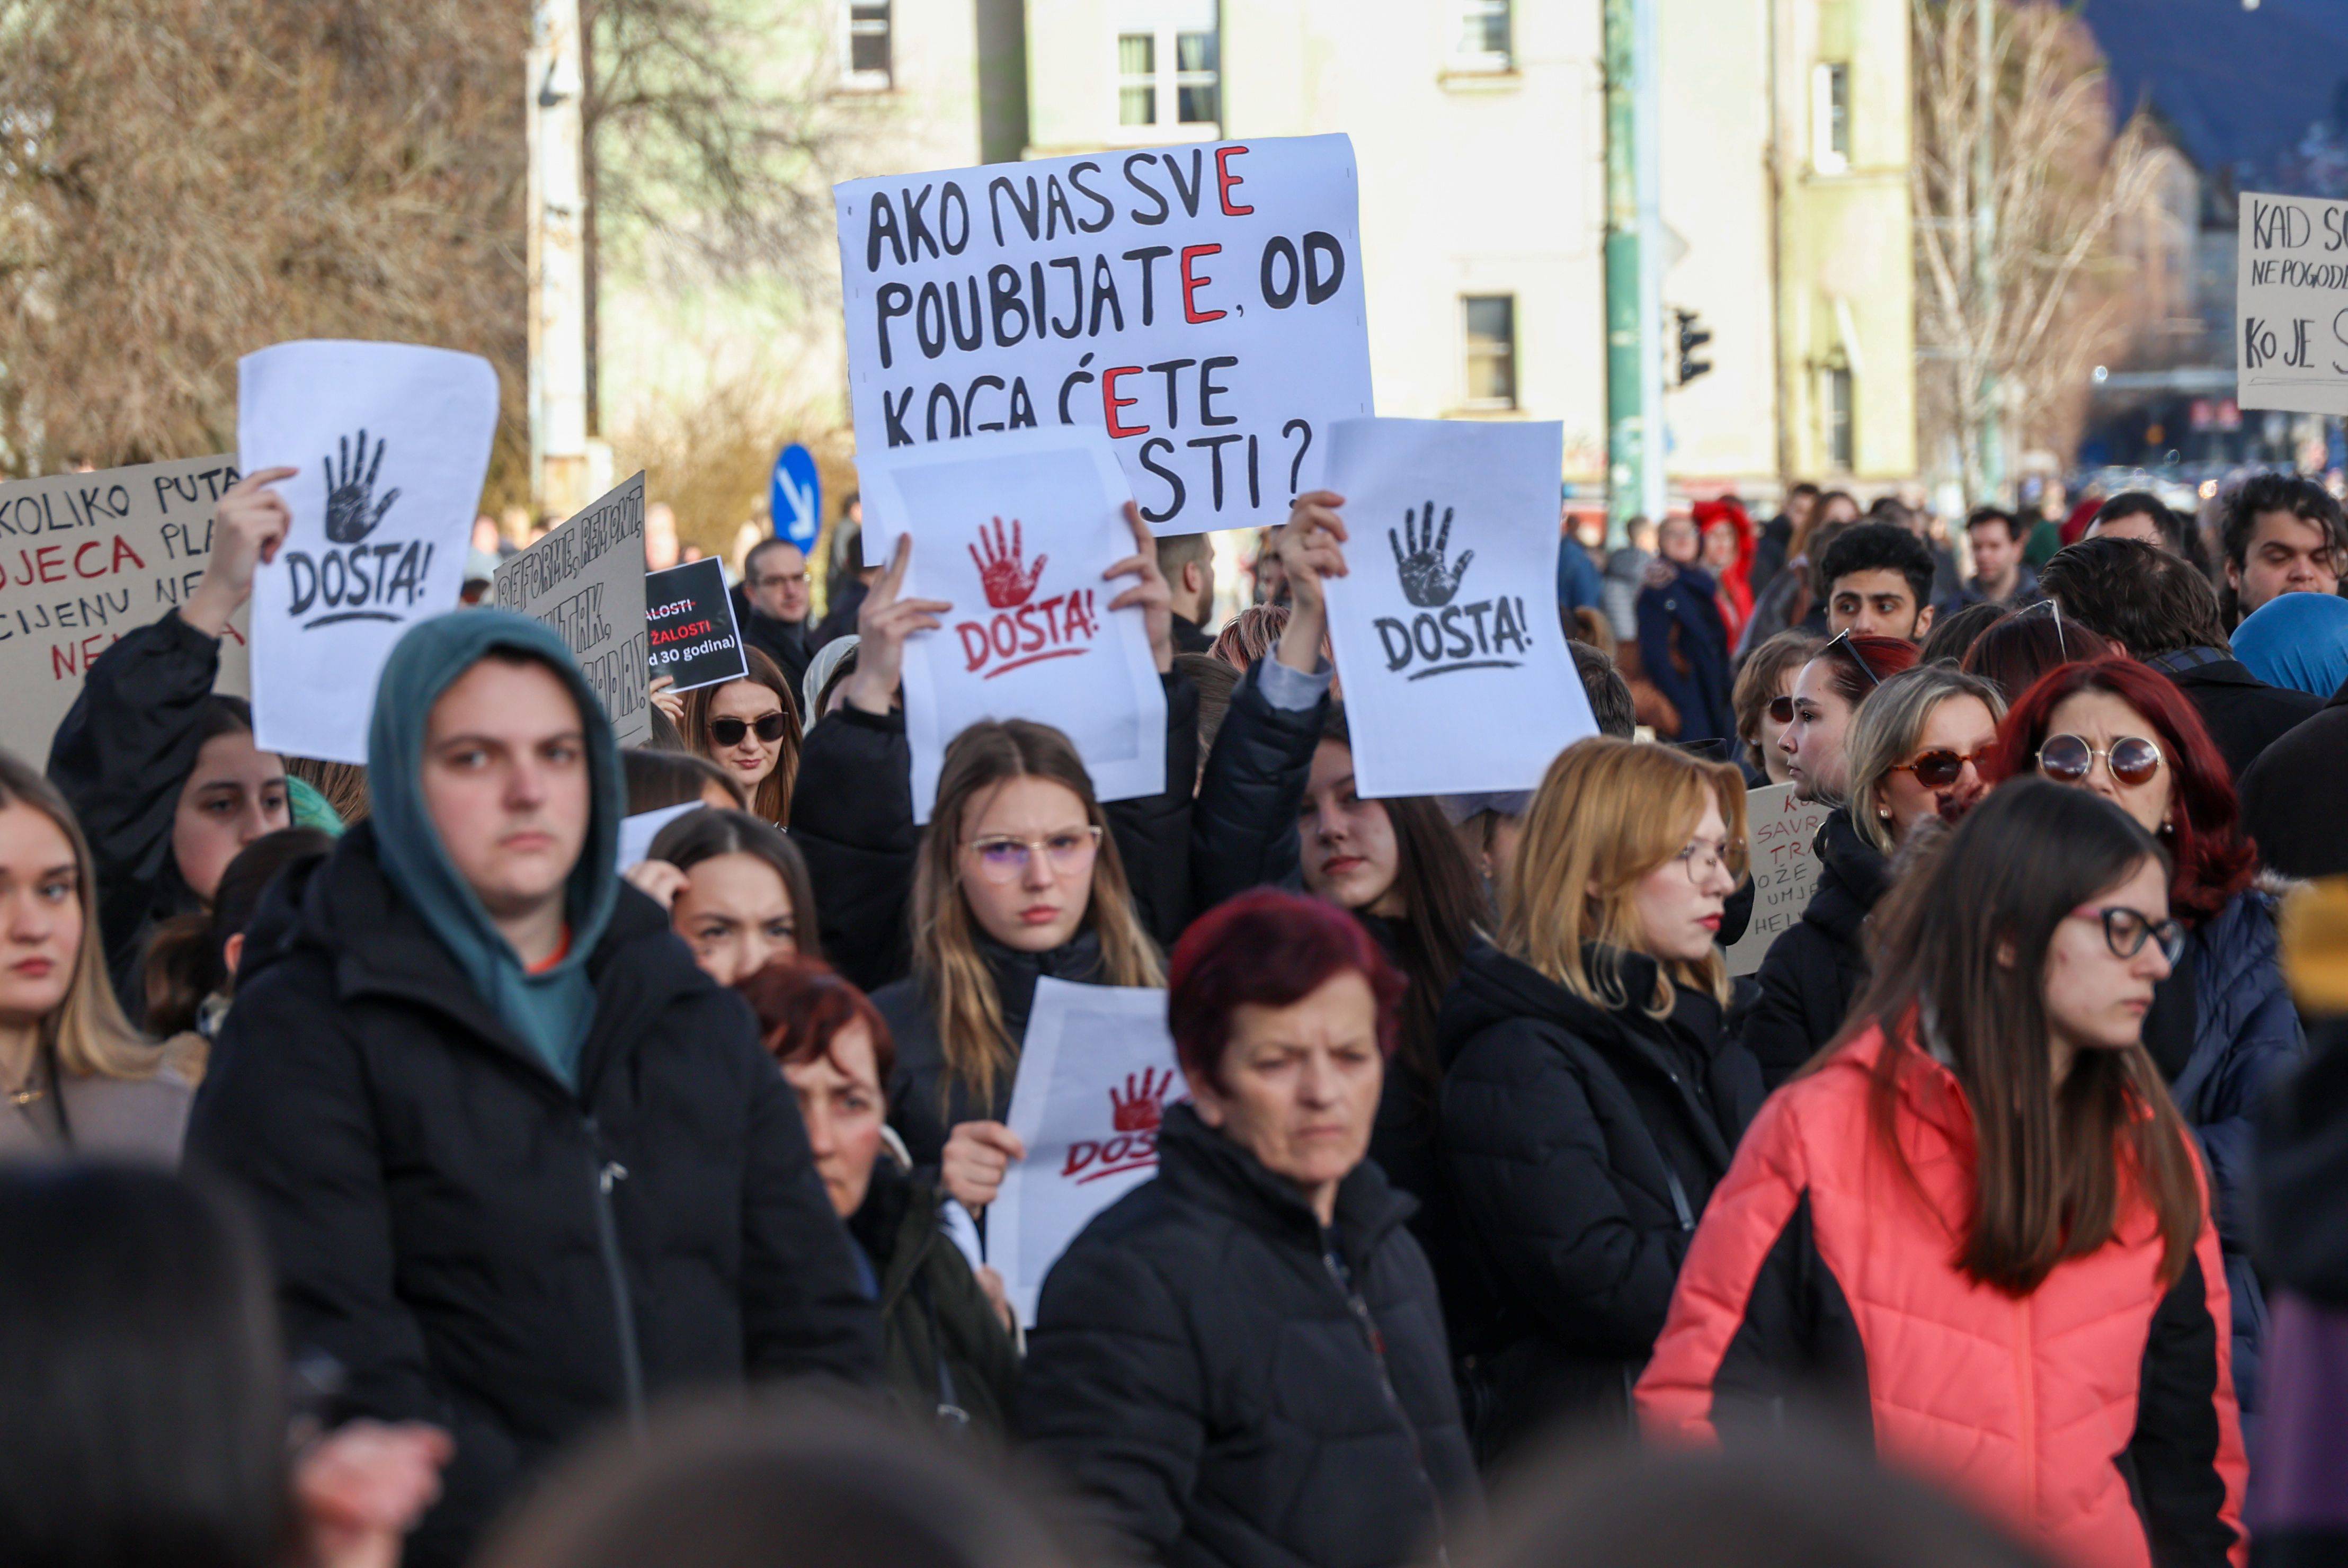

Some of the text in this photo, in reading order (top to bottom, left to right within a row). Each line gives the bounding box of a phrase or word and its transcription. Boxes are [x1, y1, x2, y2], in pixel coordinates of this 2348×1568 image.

[867, 146, 1254, 272] AKO NAS SVE
[2254, 200, 2310, 249] KAD
[876, 230, 1345, 368] POUBIJATE, OD
[2245, 318, 2277, 368] KO
[2284, 319, 2315, 368] JE
[884, 352, 1238, 448] KOGA ĆETE
[154, 467, 242, 513] PUTA
[286, 540, 434, 616] DOSTA!
[651, 619, 712, 646] ŽALOSTI
[661, 648, 680, 664] 30
[683, 634, 735, 661] godina)
[956, 589, 1100, 672] DOSTA!
[1373, 595, 1533, 672] DOSTA!
